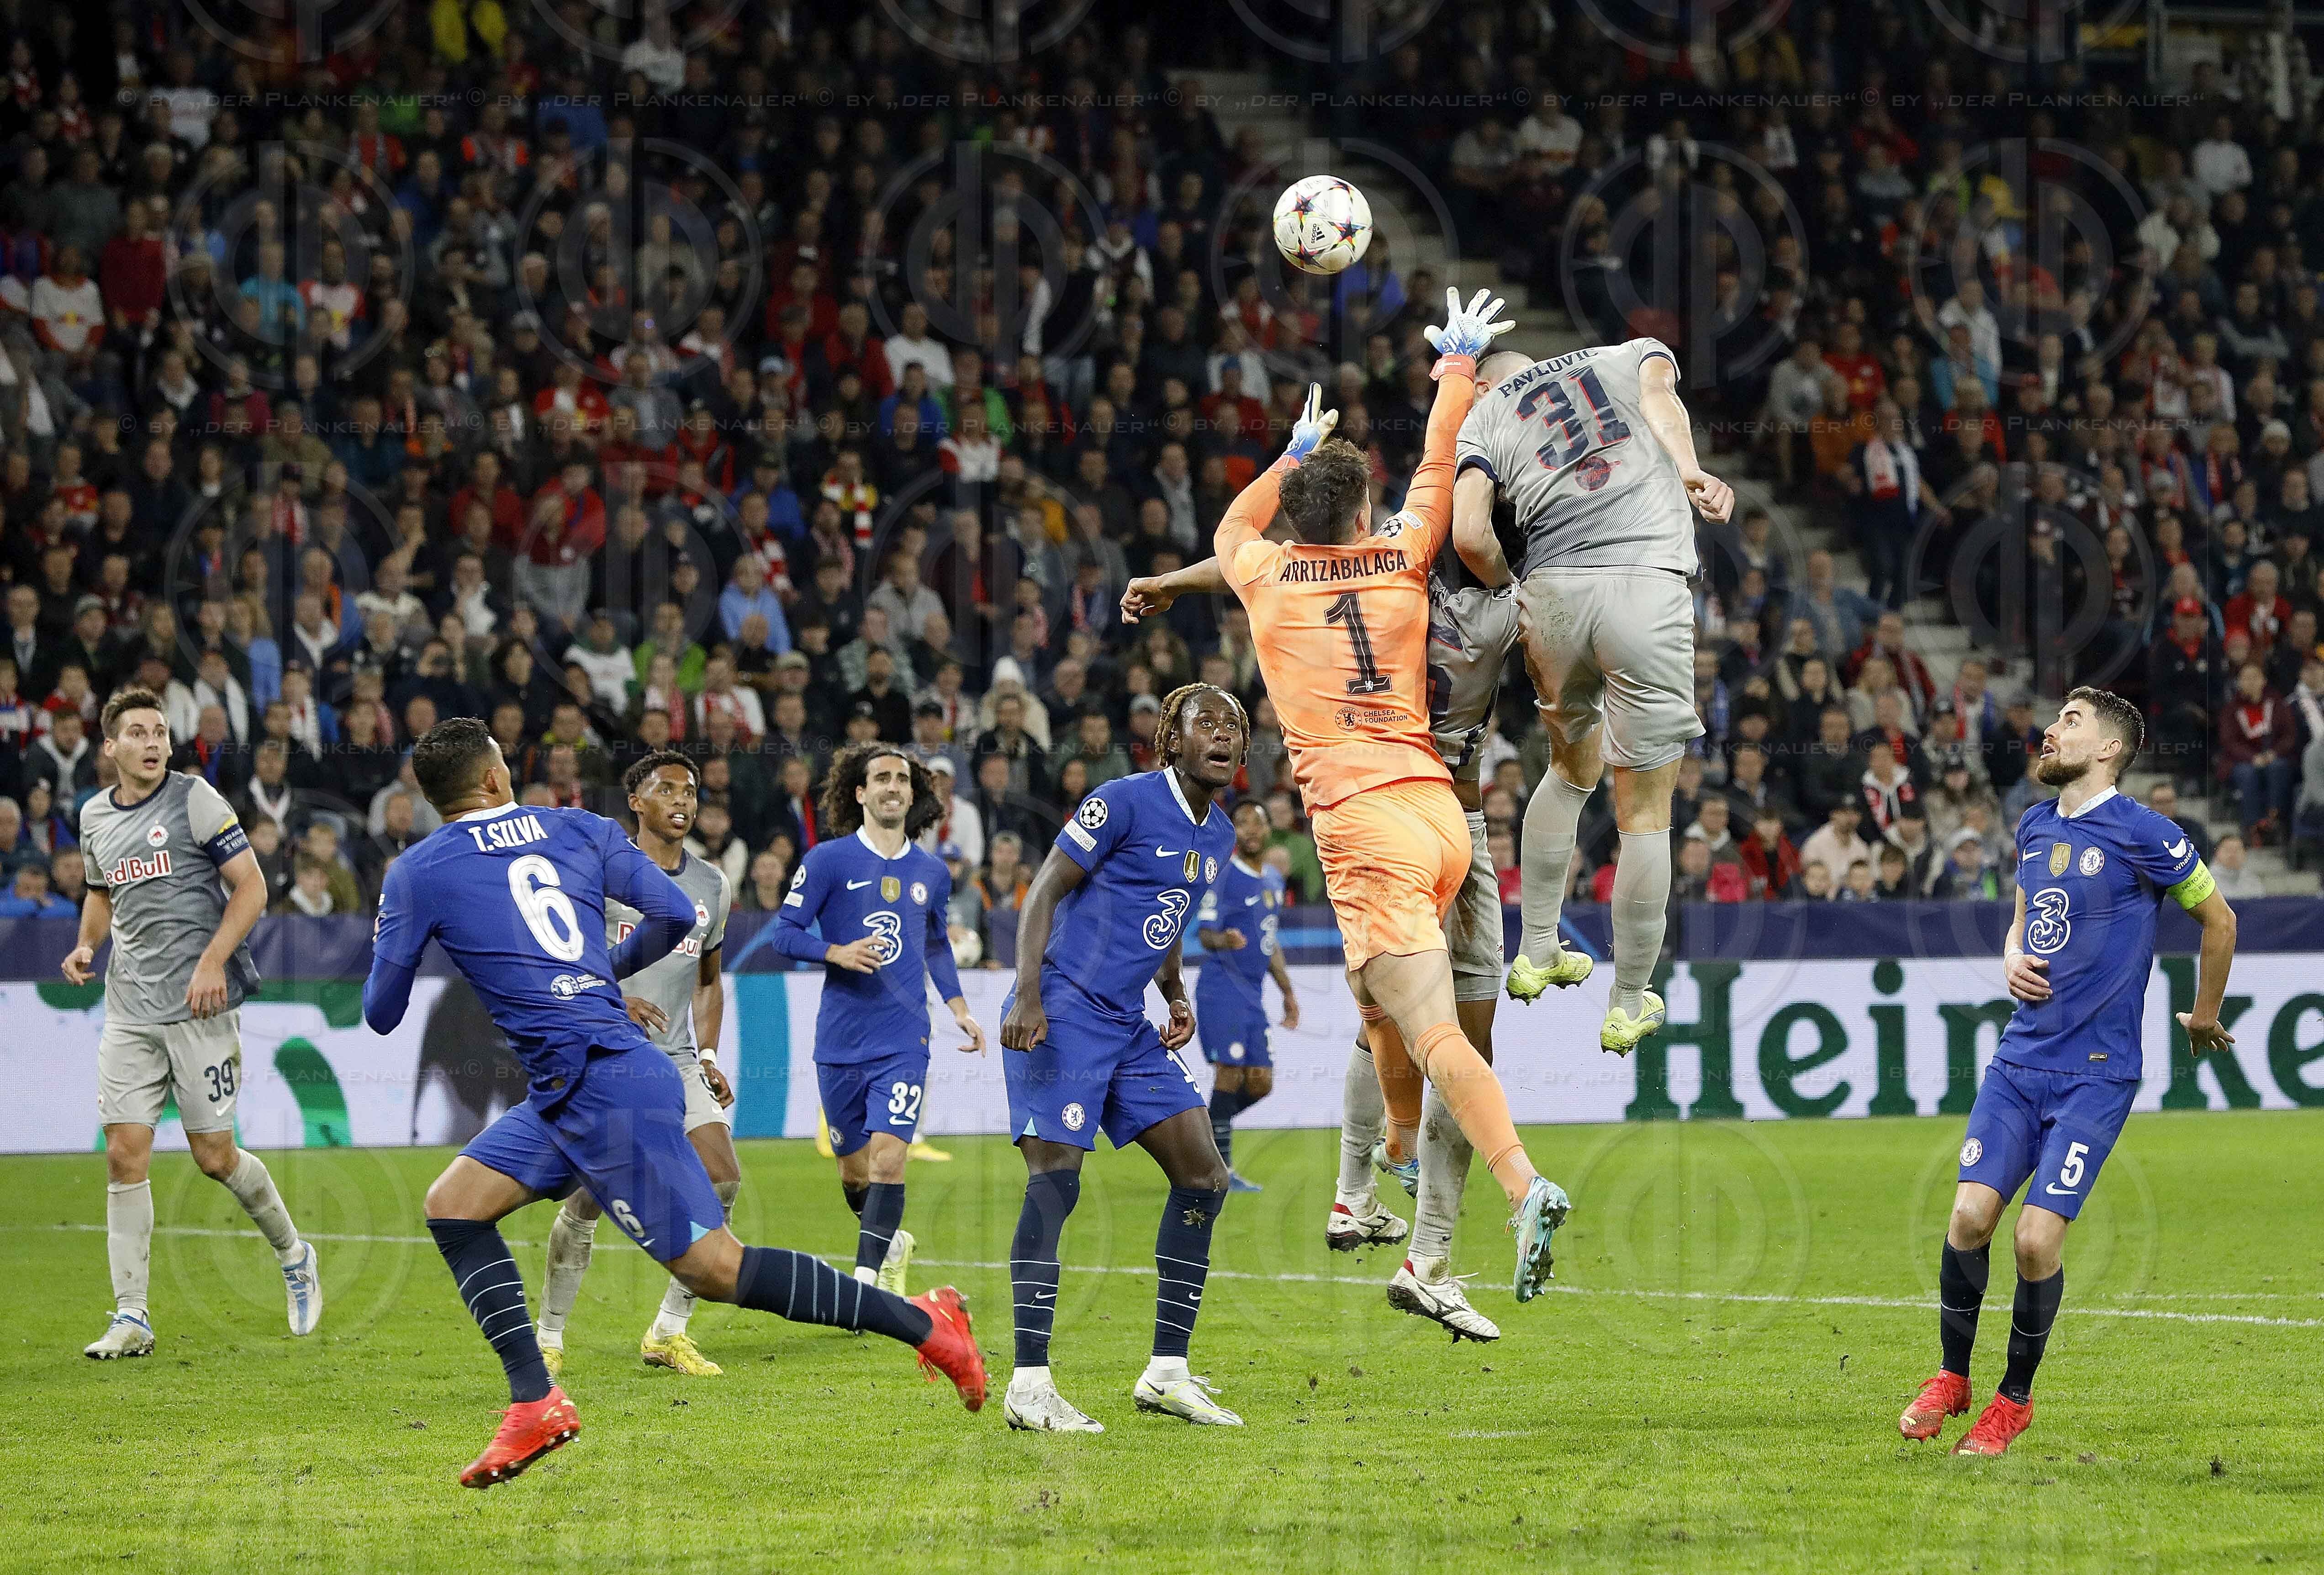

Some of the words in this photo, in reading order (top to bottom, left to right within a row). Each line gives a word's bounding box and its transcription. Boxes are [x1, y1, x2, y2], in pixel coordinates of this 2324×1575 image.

[1498, 349, 1599, 398] PAVLOVIC
[1516, 364, 1632, 470] 31
[1279, 550, 1407, 581] ARRIZABALAGA
[1324, 592, 1392, 696] 1
[1364, 715, 1407, 724] FOUNDATION
[467, 814, 548, 852] T.SILVA
[106, 861, 127, 885] ed
[129, 852, 170, 879] Bull
[2181, 882, 2191, 891] NO
[507, 854, 586, 962] 6
[204, 1059, 235, 1102] 39
[888, 1081, 922, 1120] 32
[2060, 1141, 2089, 1188] 5
[611, 1199, 646, 1238] 6
